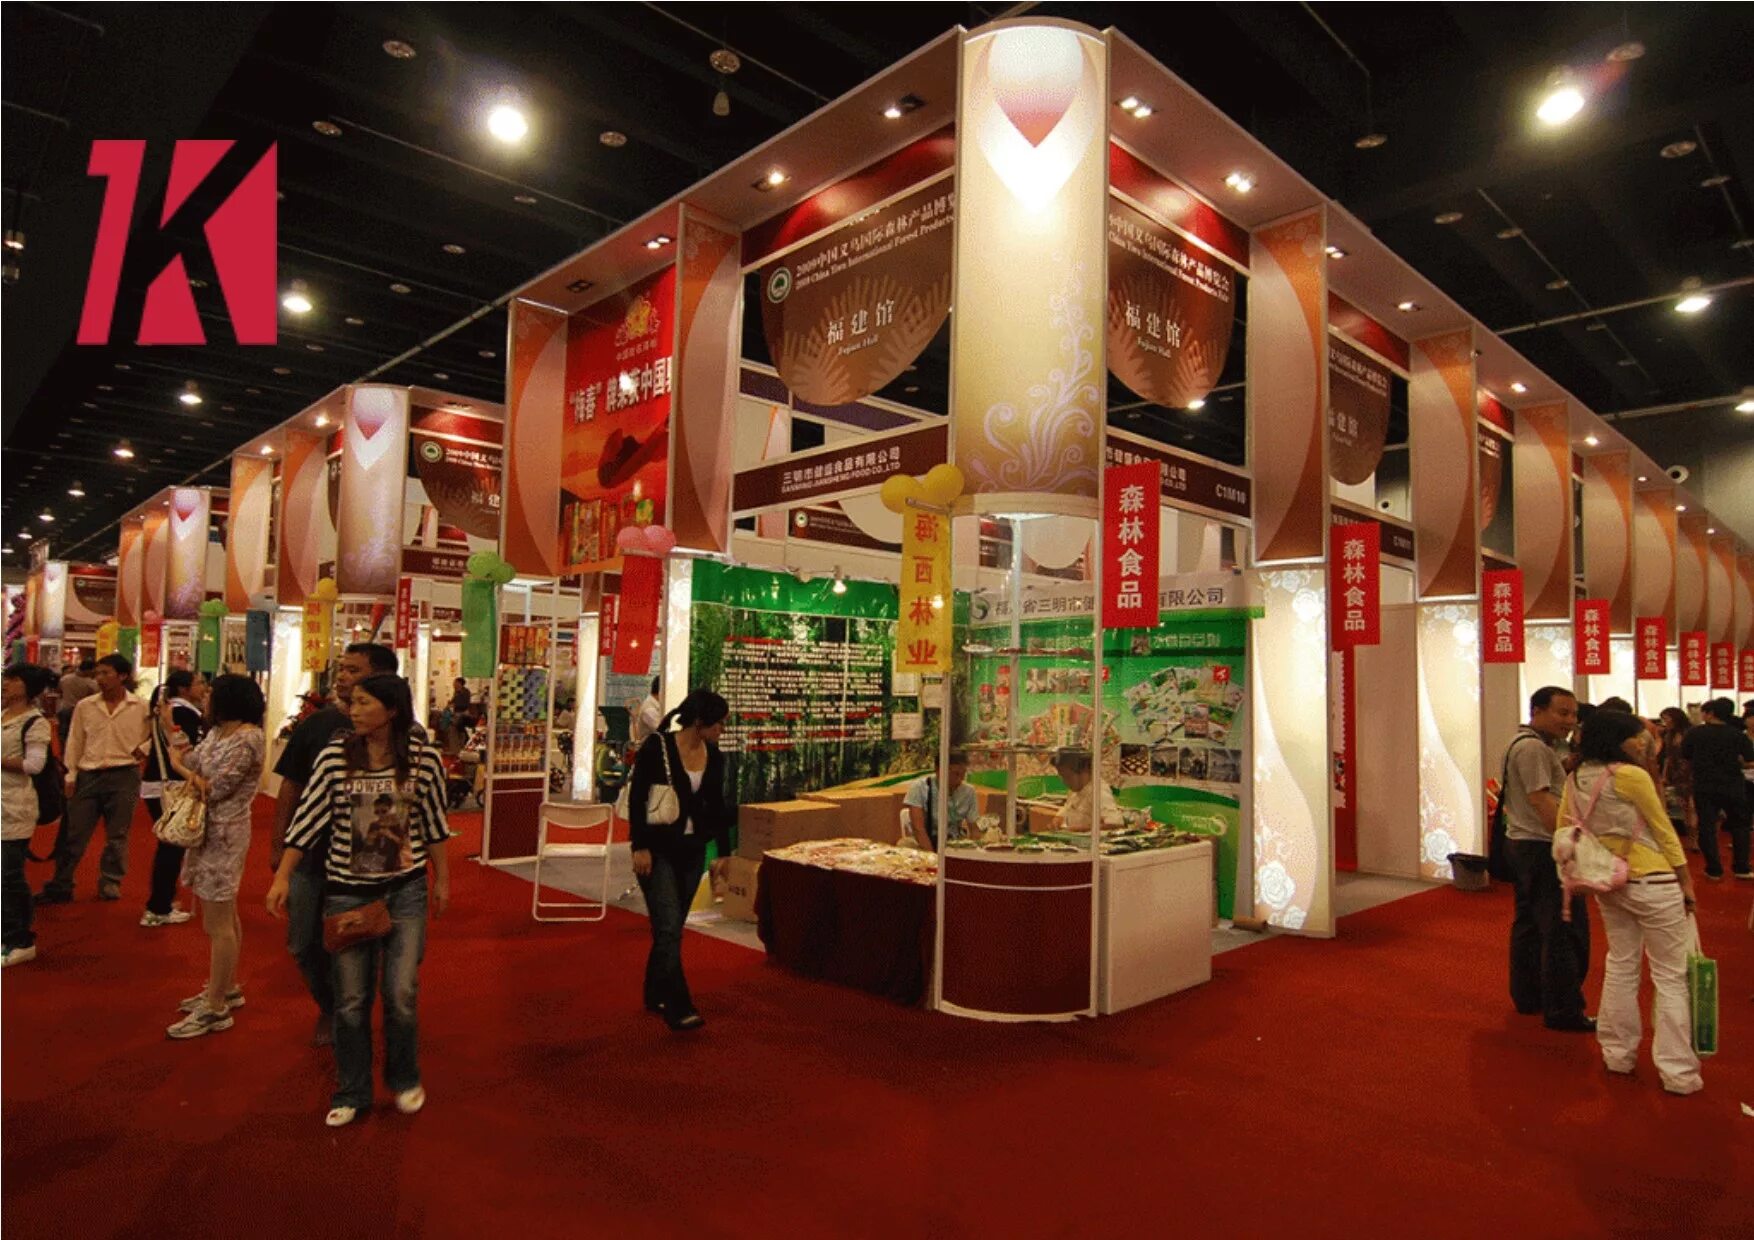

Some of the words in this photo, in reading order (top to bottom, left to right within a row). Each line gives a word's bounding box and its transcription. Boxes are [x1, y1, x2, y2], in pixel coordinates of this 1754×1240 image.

[828, 299, 895, 345] 福建馆
[1125, 300, 1181, 348] 福建馆
[1117, 484, 1144, 608] 森林食品
[1343, 538, 1366, 631] 森林食品
[1493, 582, 1513, 652] 森林食品
[1584, 608, 1601, 666] 森林食品
[1644, 624, 1659, 673] 森林食品
